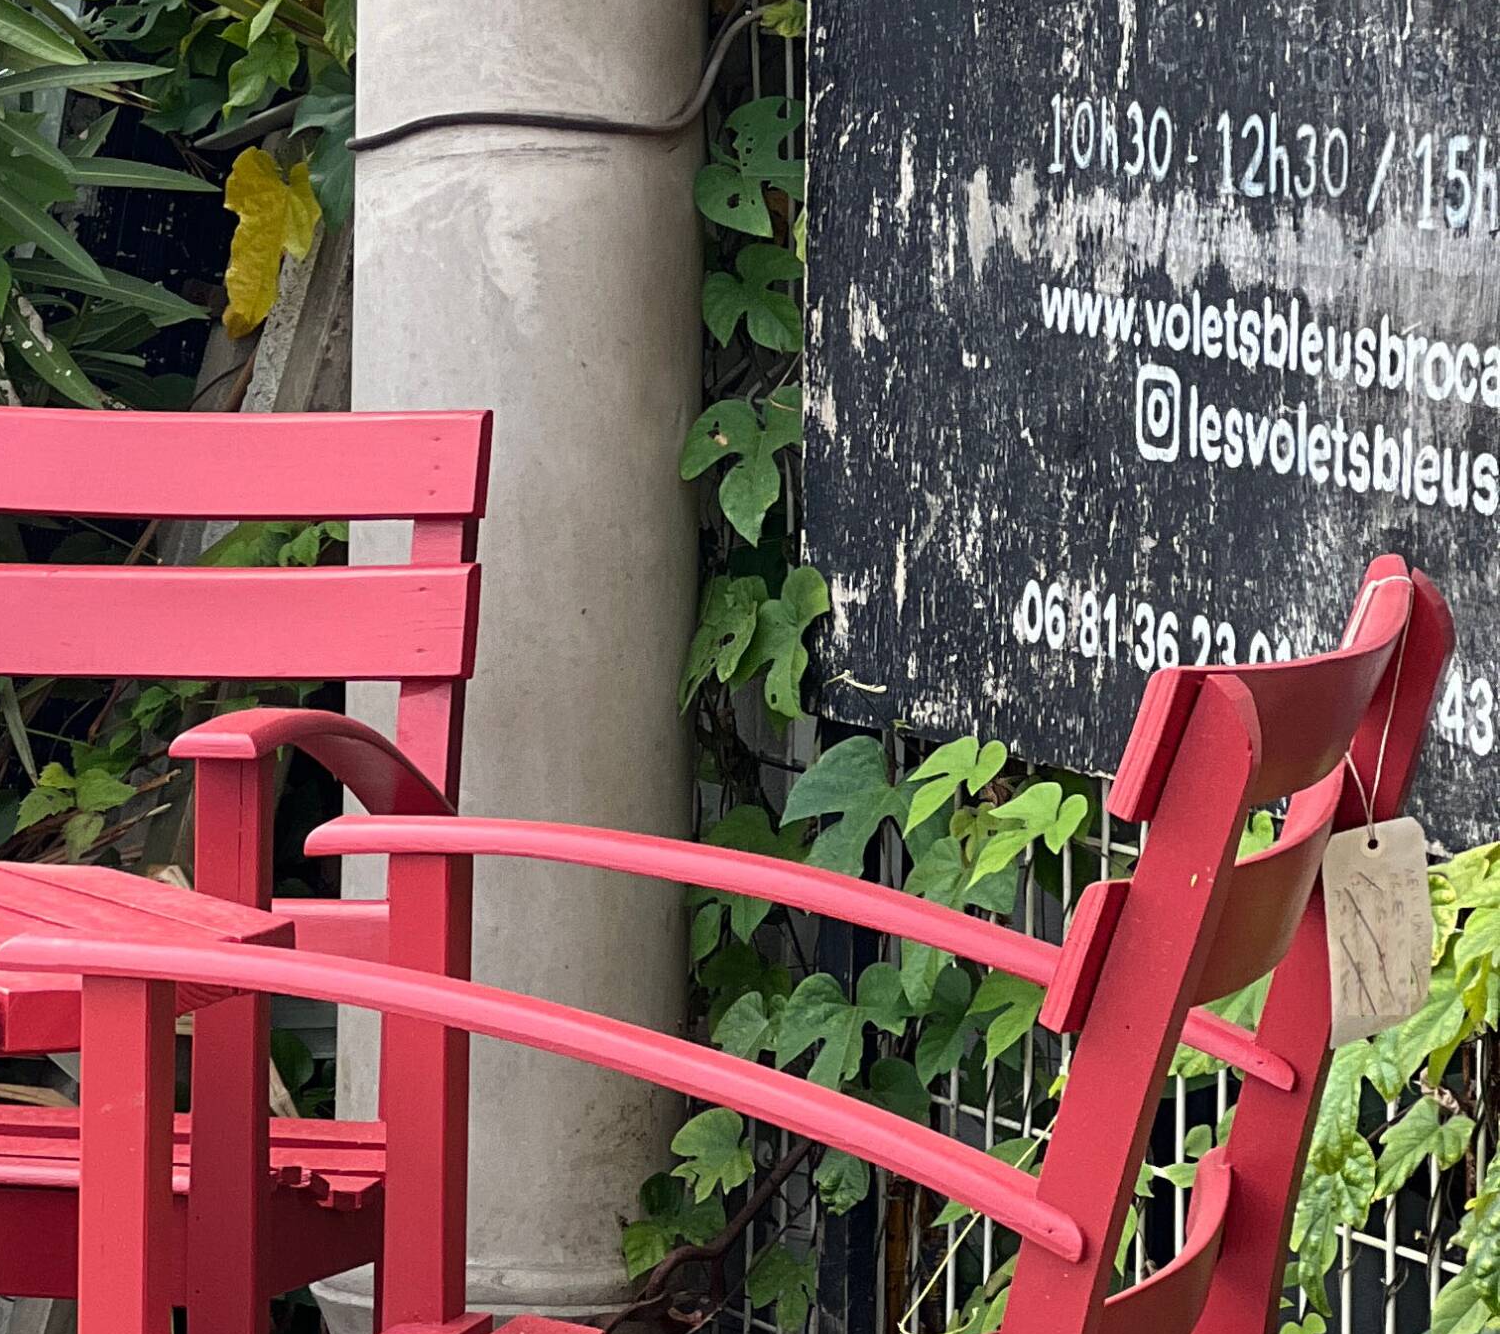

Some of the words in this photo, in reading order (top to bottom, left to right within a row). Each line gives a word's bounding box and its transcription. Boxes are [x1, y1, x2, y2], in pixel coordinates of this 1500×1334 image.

[1048, 93, 1172, 182] 10h30
[1216, 111, 1348, 198] 12h30
[1414, 132, 1498, 230] 15h
[1041, 282, 1500, 409] www.voletsbleusbroca
[1189, 384, 1500, 516] lesvoletsbleus
[1022, 579, 1067, 650] 06
[1079, 590, 1117, 659] 81
[1135, 602, 1179, 672] 36
